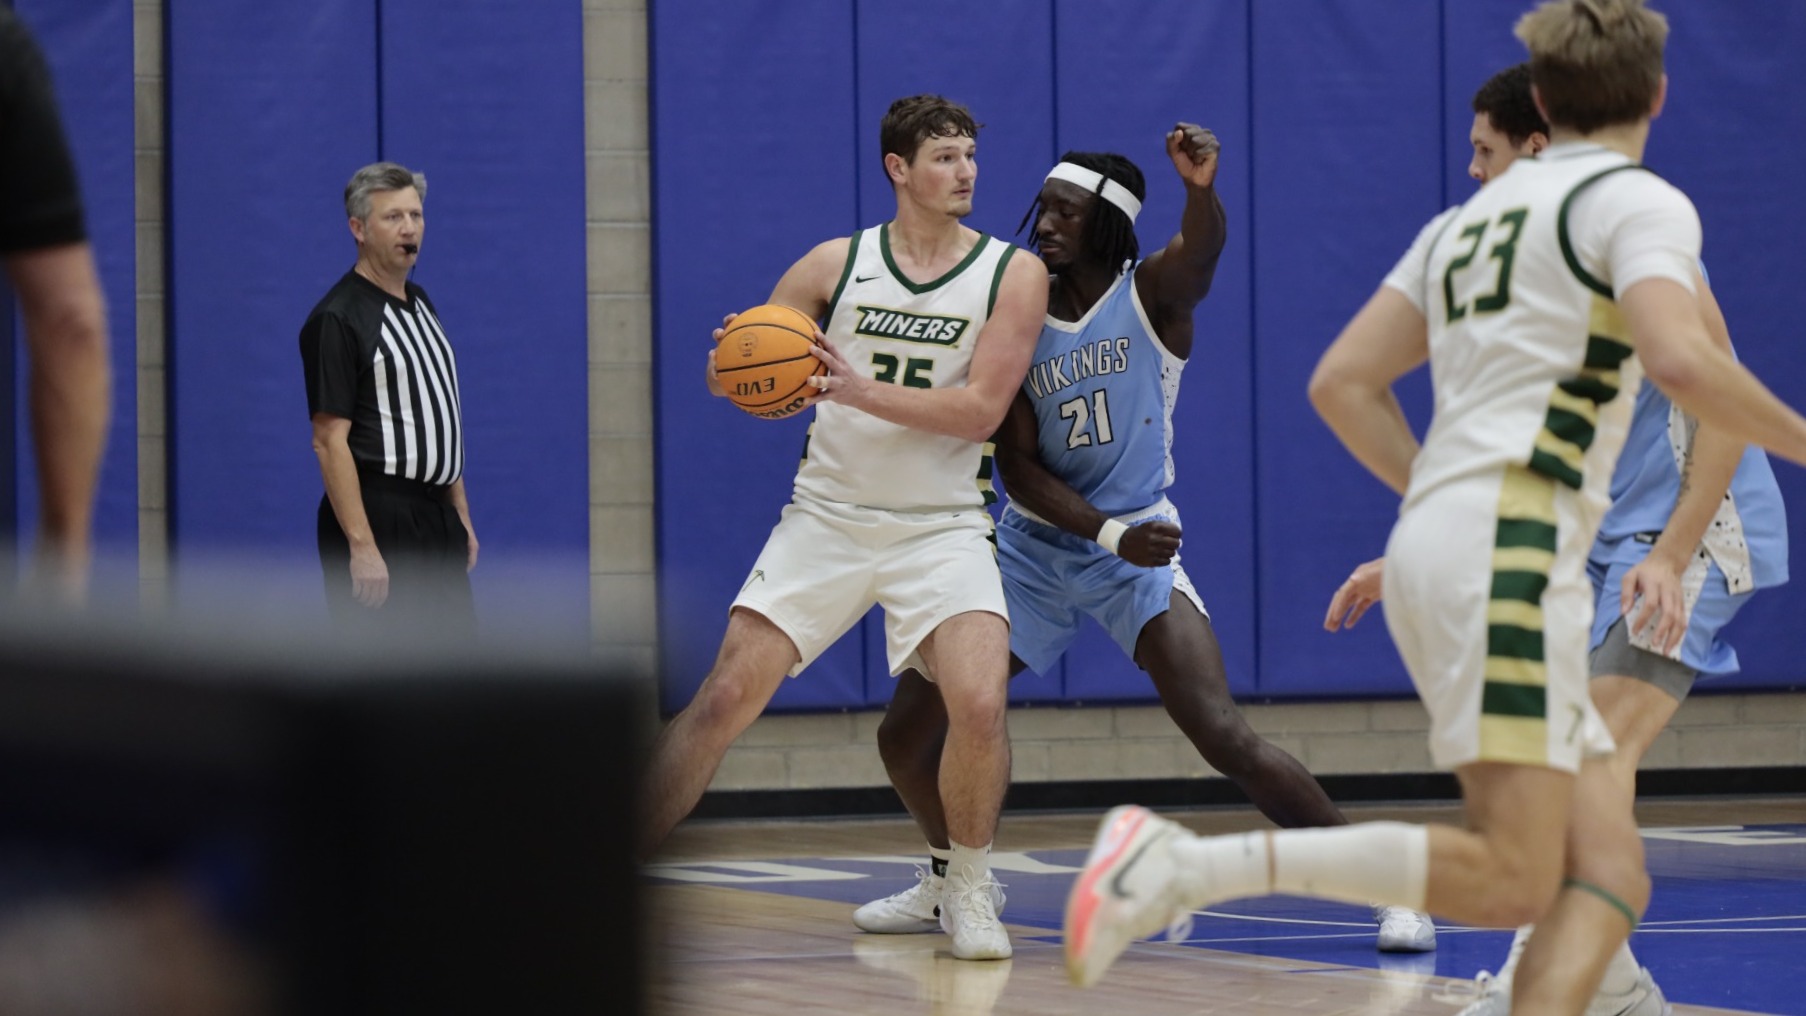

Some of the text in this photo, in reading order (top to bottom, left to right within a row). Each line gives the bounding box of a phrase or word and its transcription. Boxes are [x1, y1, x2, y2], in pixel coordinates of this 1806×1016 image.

[1444, 205, 1529, 325] 23
[859, 309, 963, 341] MINERS
[1027, 337, 1130, 399] VIKINGS
[1059, 388, 1114, 451] 21
